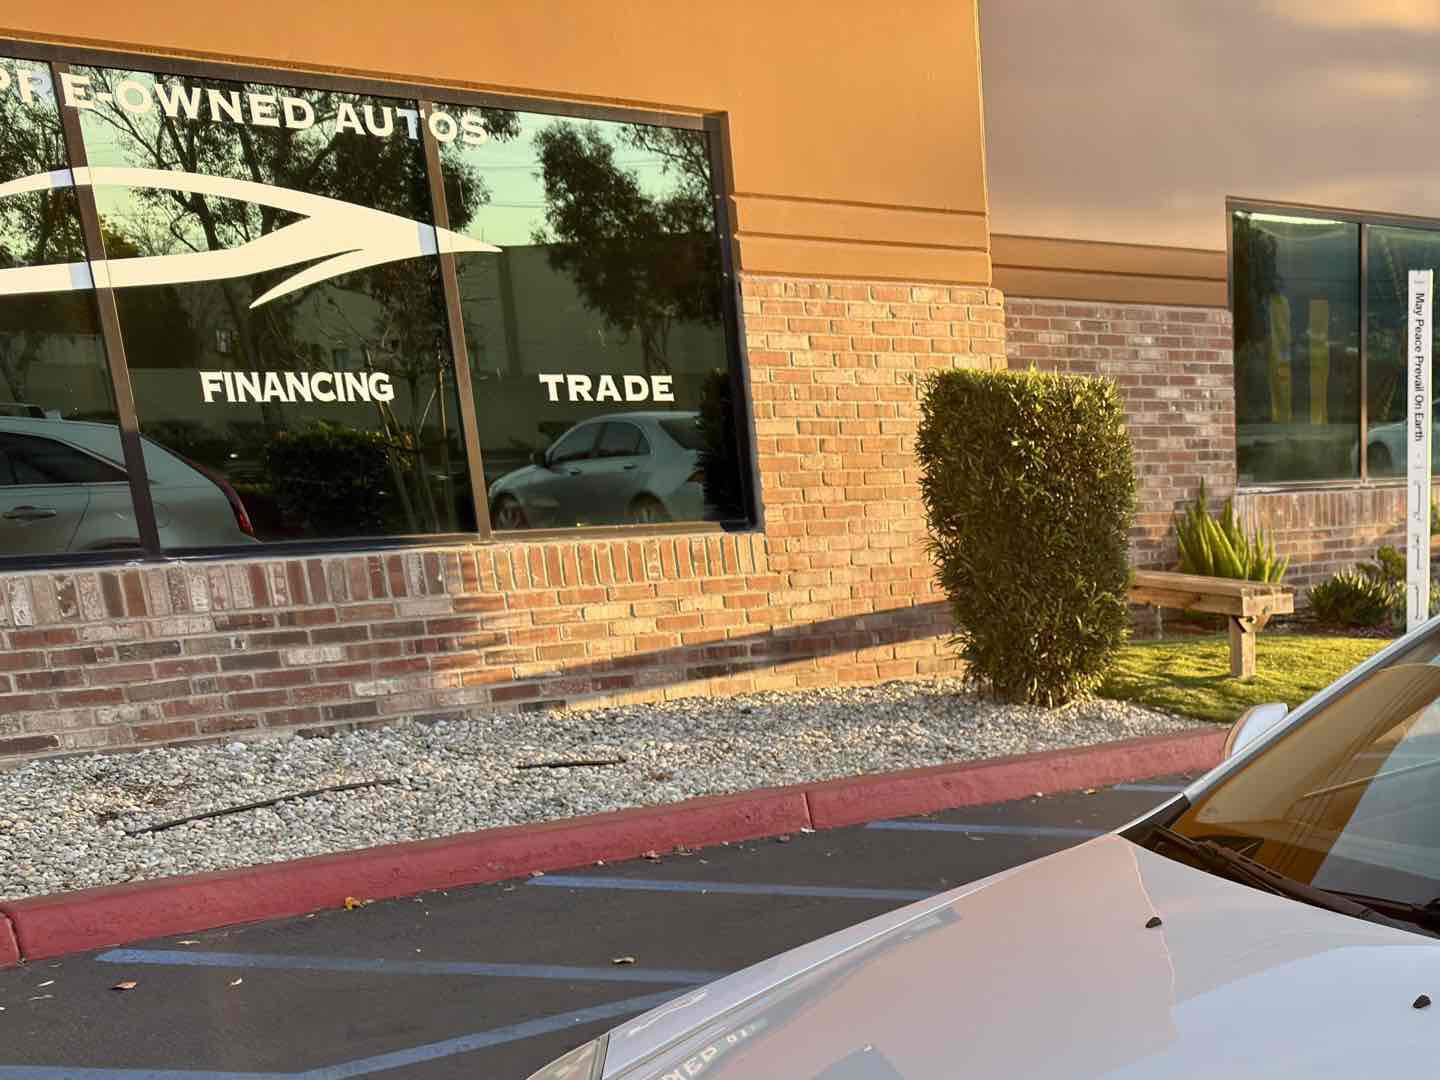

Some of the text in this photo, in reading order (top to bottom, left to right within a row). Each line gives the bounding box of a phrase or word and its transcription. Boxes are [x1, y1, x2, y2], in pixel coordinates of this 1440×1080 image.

[335, 102, 488, 145] AUTOS
[1413, 292, 1425, 442] May Peace Prevail On Earth
[200, 370, 395, 404] FINANCING
[538, 373, 675, 403] TRADE
